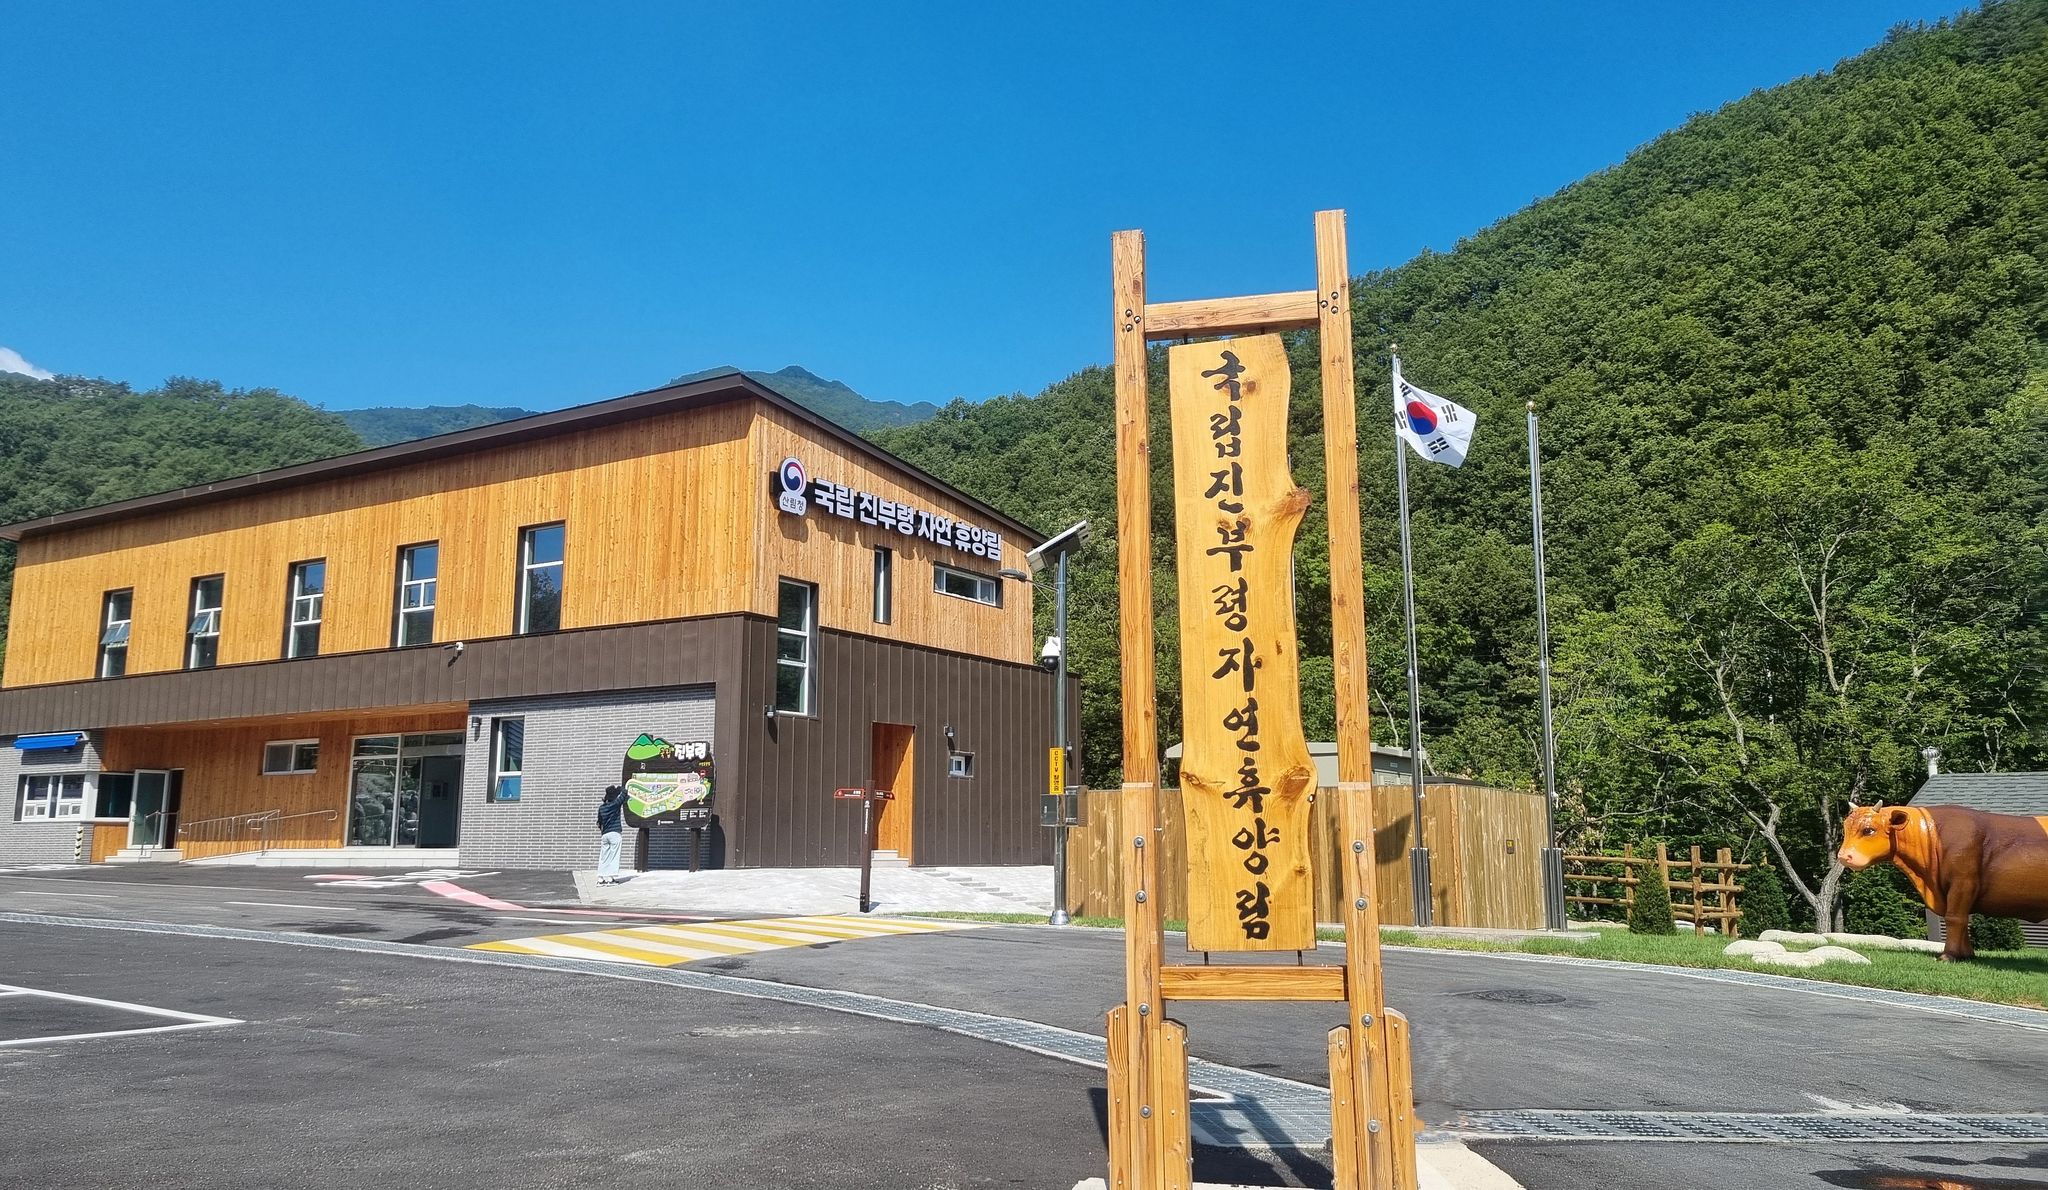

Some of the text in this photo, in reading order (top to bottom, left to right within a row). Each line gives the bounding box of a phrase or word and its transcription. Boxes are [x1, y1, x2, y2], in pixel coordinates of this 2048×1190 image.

[782, 495, 804, 512] 산림청
[814, 478, 1002, 562] 국립 진부령 자연 휴양림
[674, 742, 707, 760] 진부령
